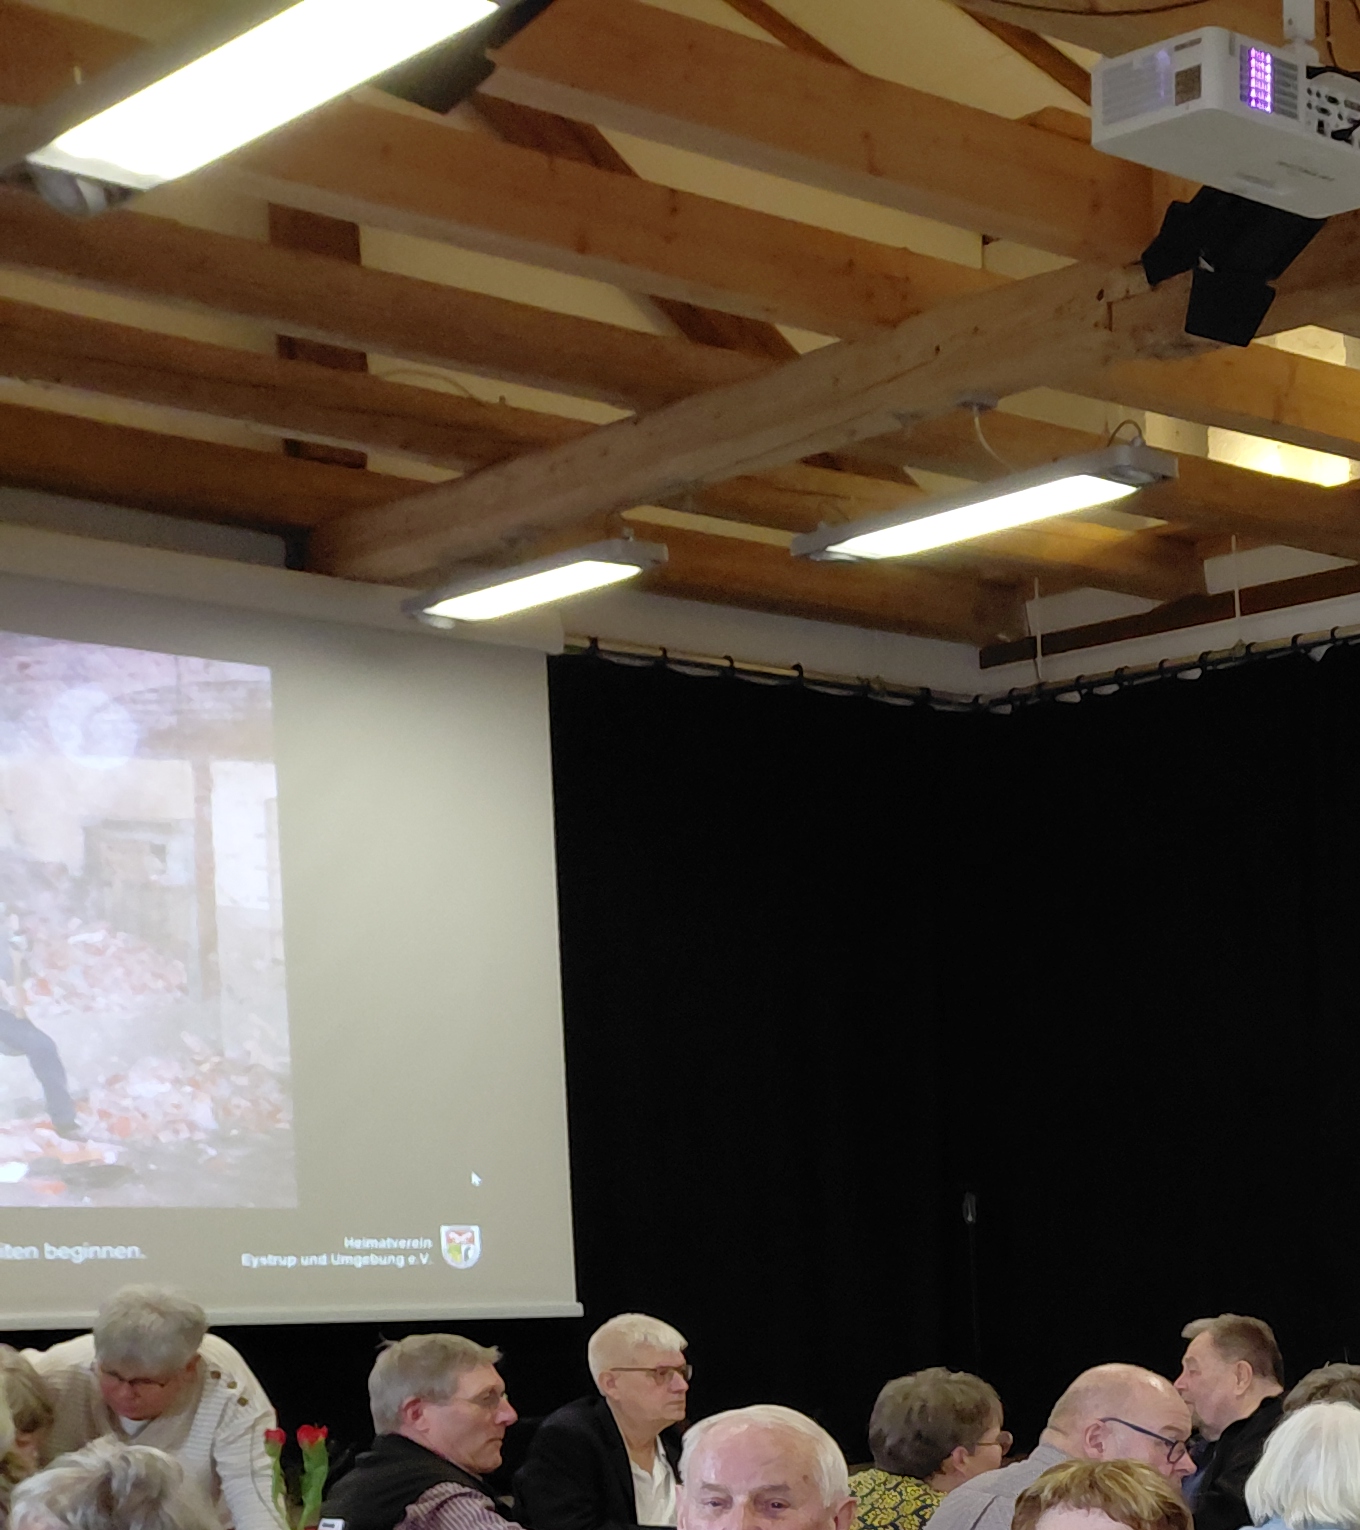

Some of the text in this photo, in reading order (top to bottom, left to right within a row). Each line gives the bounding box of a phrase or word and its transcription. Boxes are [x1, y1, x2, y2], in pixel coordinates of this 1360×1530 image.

[344, 1236, 433, 1249] Heimatverein
[43, 1241, 147, 1264] beginnen.
[241, 1253, 297, 1268] Eystrup
[300, 1253, 327, 1266] und
[331, 1253, 405, 1268] Umgebung
